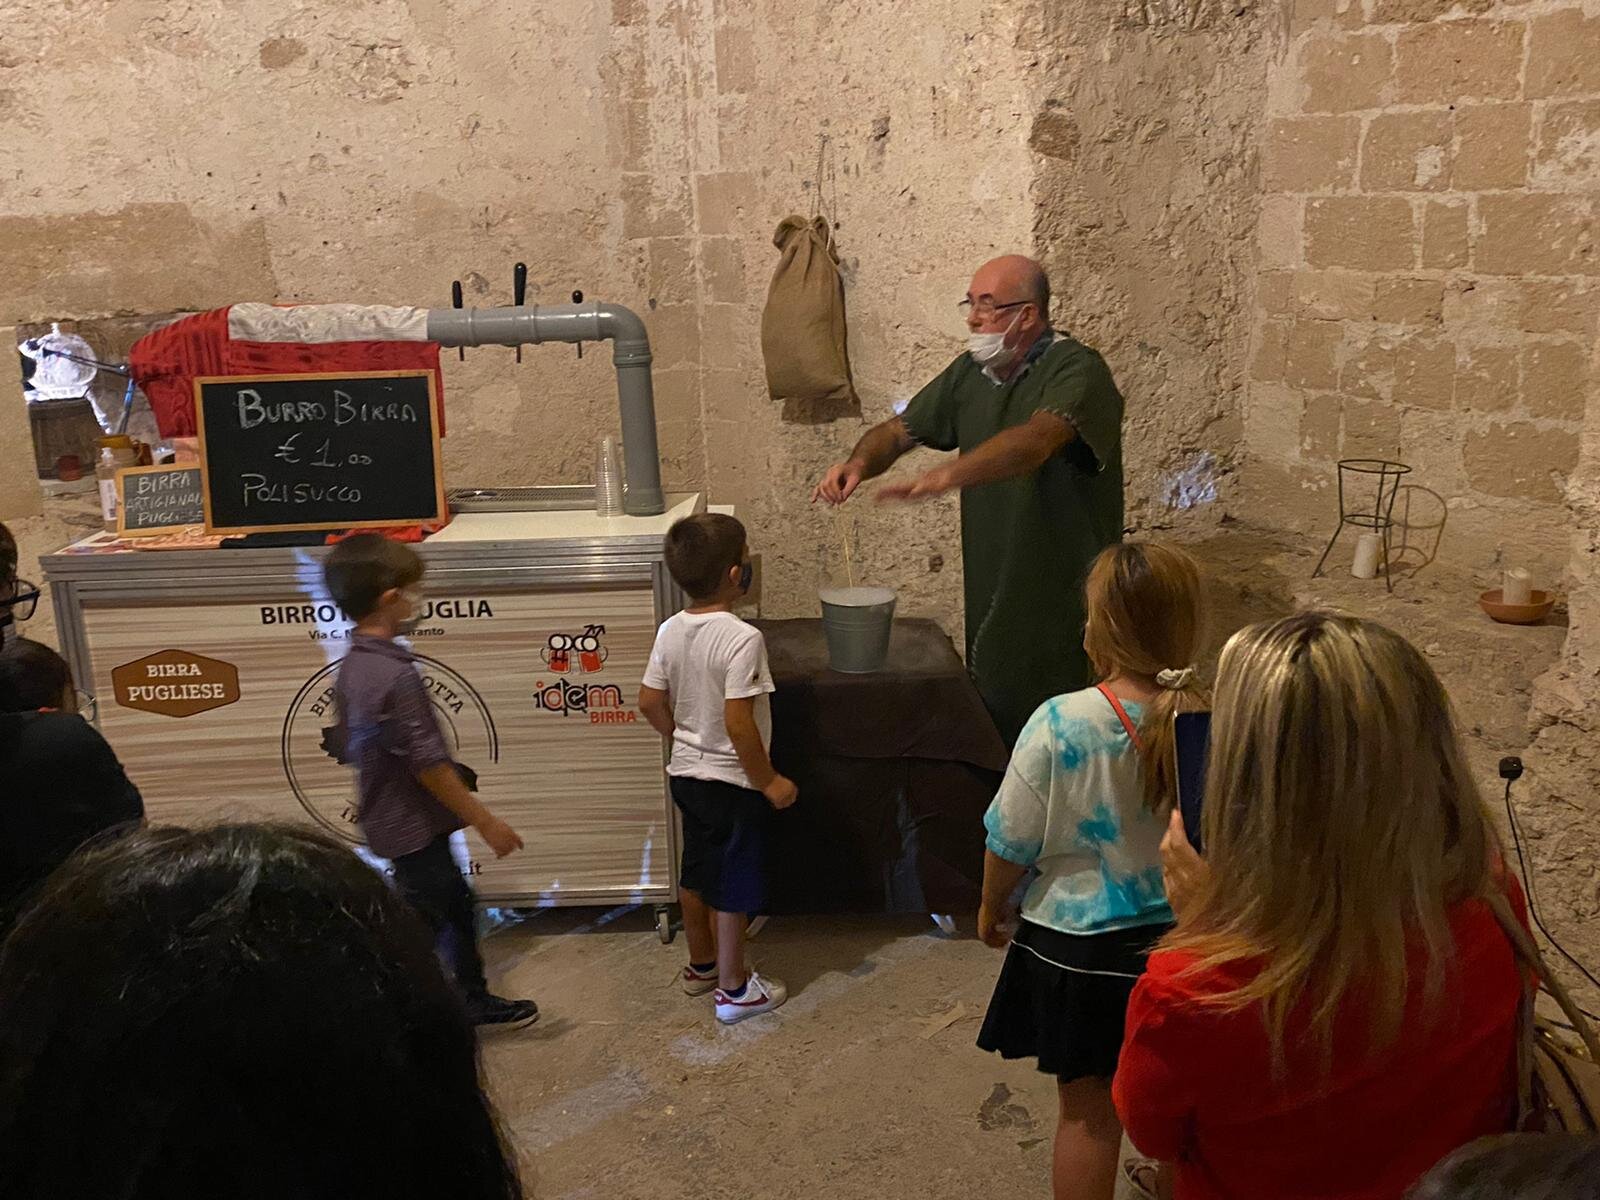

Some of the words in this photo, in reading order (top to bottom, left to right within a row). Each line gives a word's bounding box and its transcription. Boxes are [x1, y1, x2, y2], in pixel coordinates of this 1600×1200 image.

[237, 389, 326, 428] BURRO
[274, 432, 302, 463] €
[137, 472, 191, 494] BIRRA
[241, 473, 362, 506] POLISUCCO
[126, 493, 204, 512] ARTIGIANAL
[420, 600, 493, 620] UGLIA
[309, 629, 328, 640] Via
[146, 663, 202, 678] BIRRA
[127, 683, 225, 702] PUGLIESE
[421, 675, 464, 714] OTTA
[590, 710, 637, 724] BIRRA
